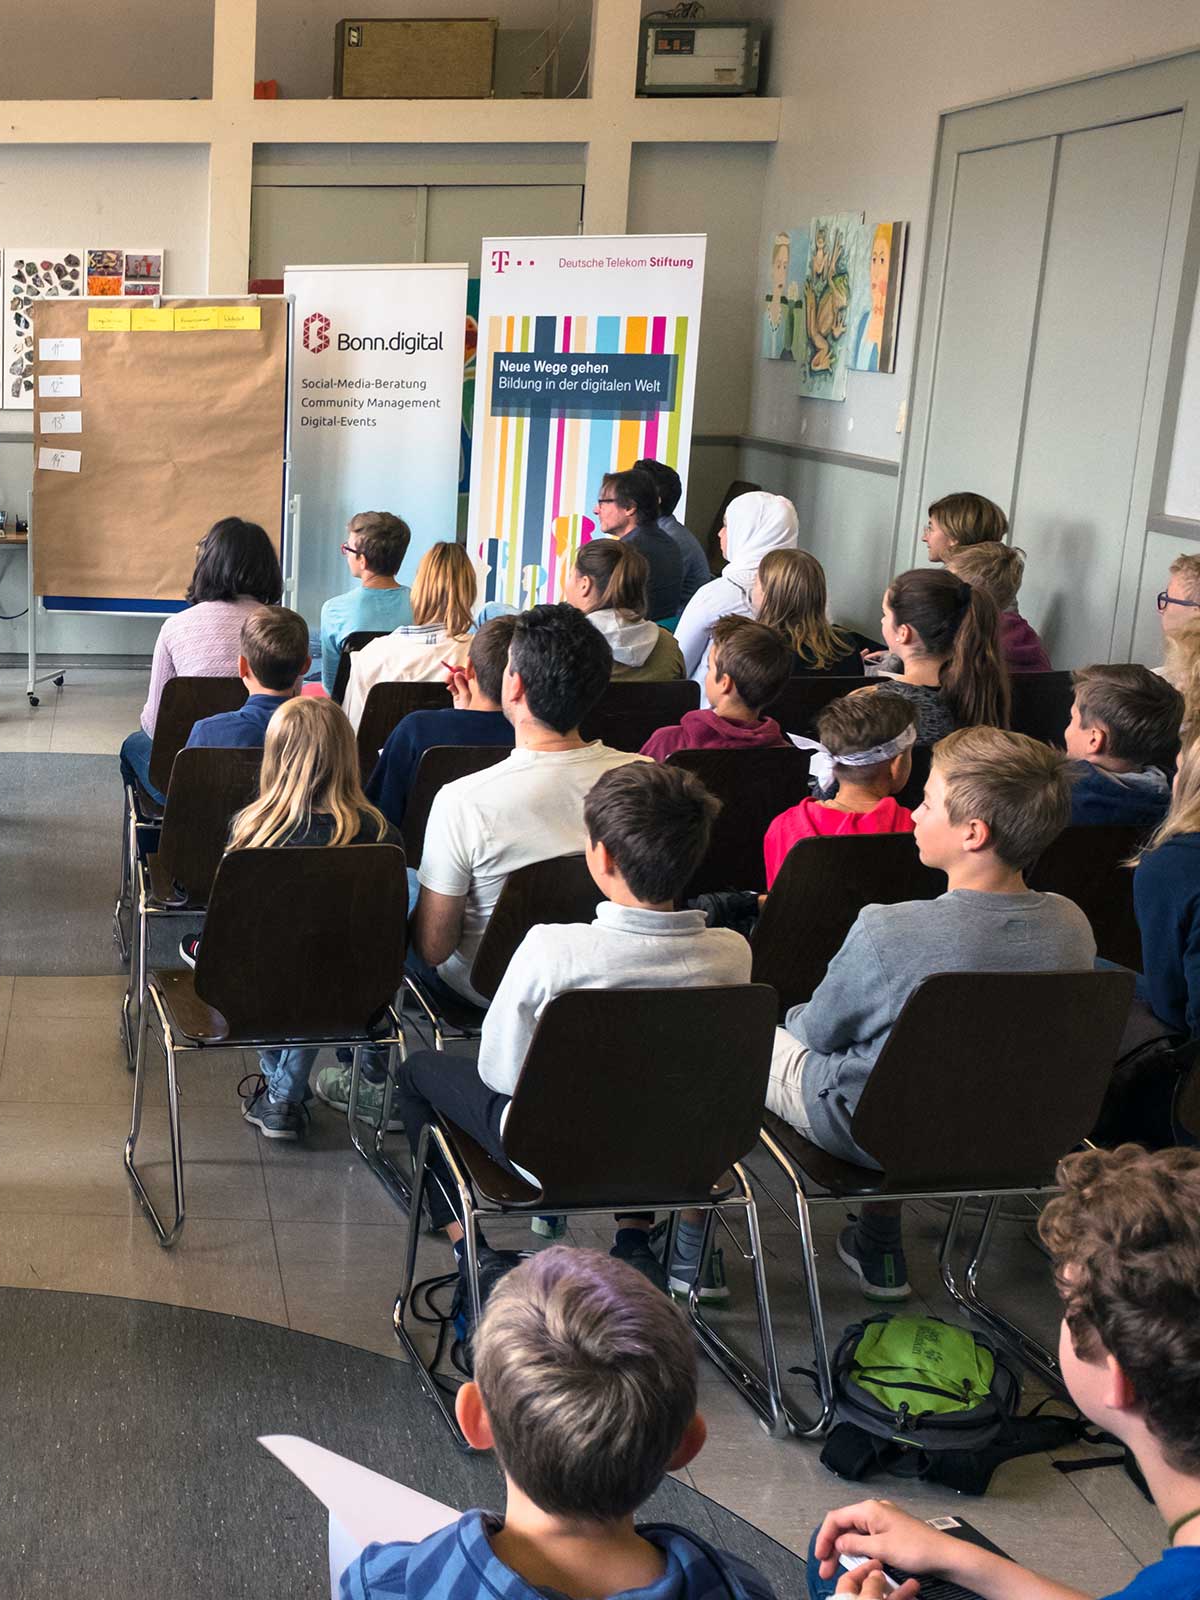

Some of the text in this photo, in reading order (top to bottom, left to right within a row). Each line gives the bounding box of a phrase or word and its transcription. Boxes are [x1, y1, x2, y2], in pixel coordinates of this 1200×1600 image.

[558, 256, 694, 269] Deutsche Telekom Stiftung
[337, 331, 444, 355] Bonn.digital
[499, 360, 609, 376] Neue Wege gehen
[301, 378, 427, 391] Social-Media-Beratung
[498, 377, 661, 394] Bildung in der digitalen Welt
[301, 397, 441, 410] Community Management
[300, 416, 377, 428] Digital-Events
